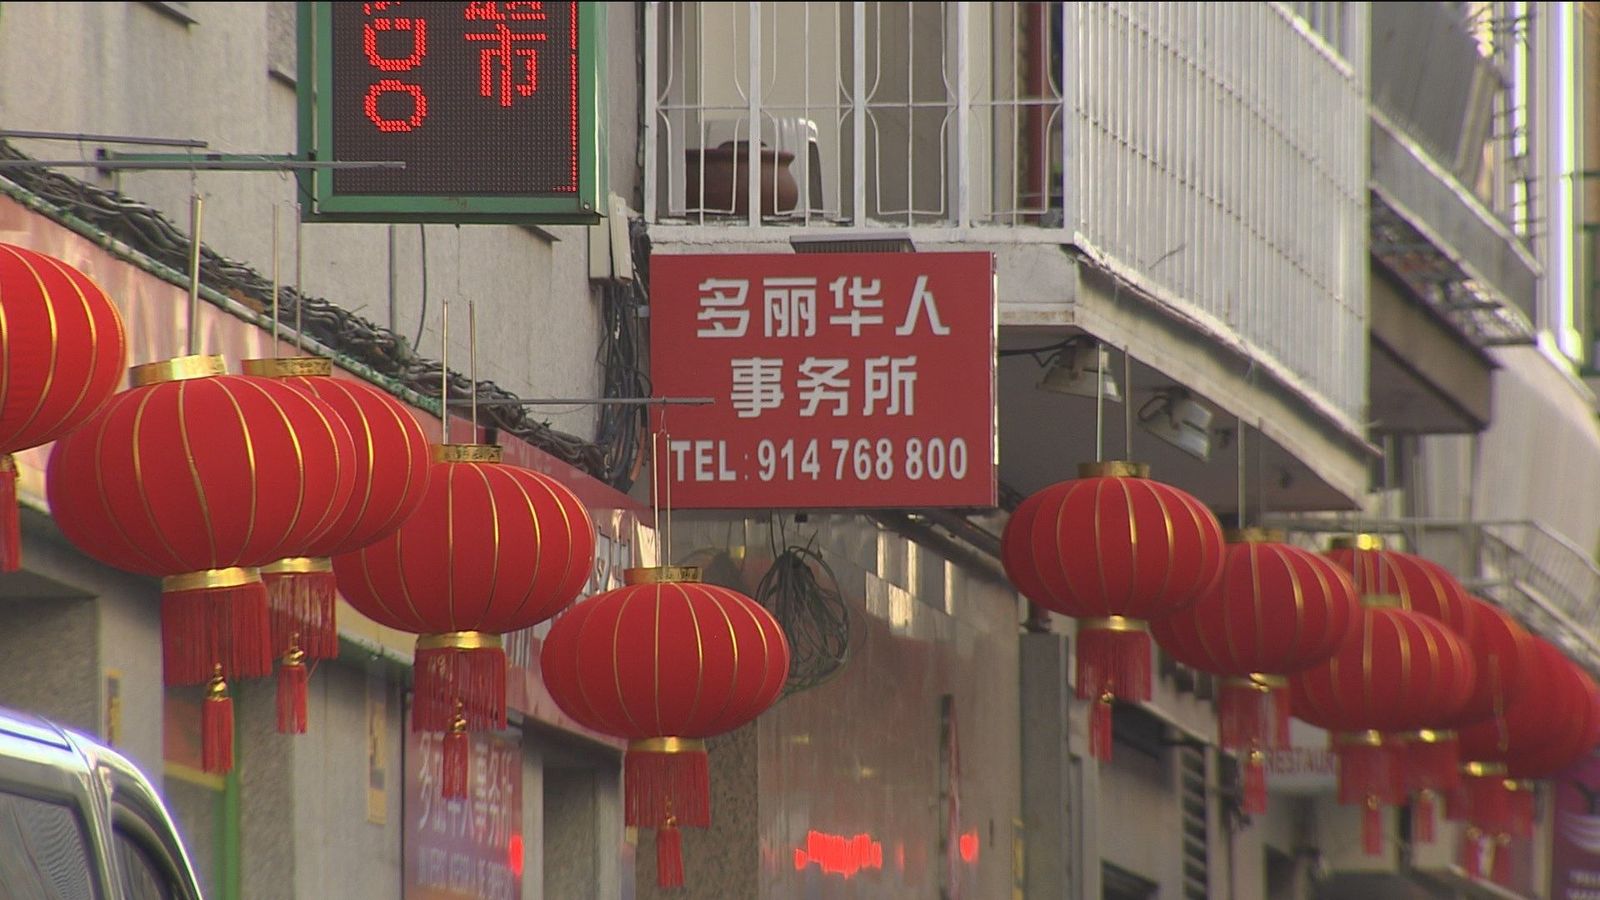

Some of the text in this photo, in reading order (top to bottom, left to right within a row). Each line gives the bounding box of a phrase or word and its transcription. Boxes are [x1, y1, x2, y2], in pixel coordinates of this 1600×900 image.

[465, 2, 547, 107] 市
[697, 275, 950, 338] 多丽华人
[730, 355, 917, 418] 事务所
[670, 437, 967, 482] TEL: 914 768 800
